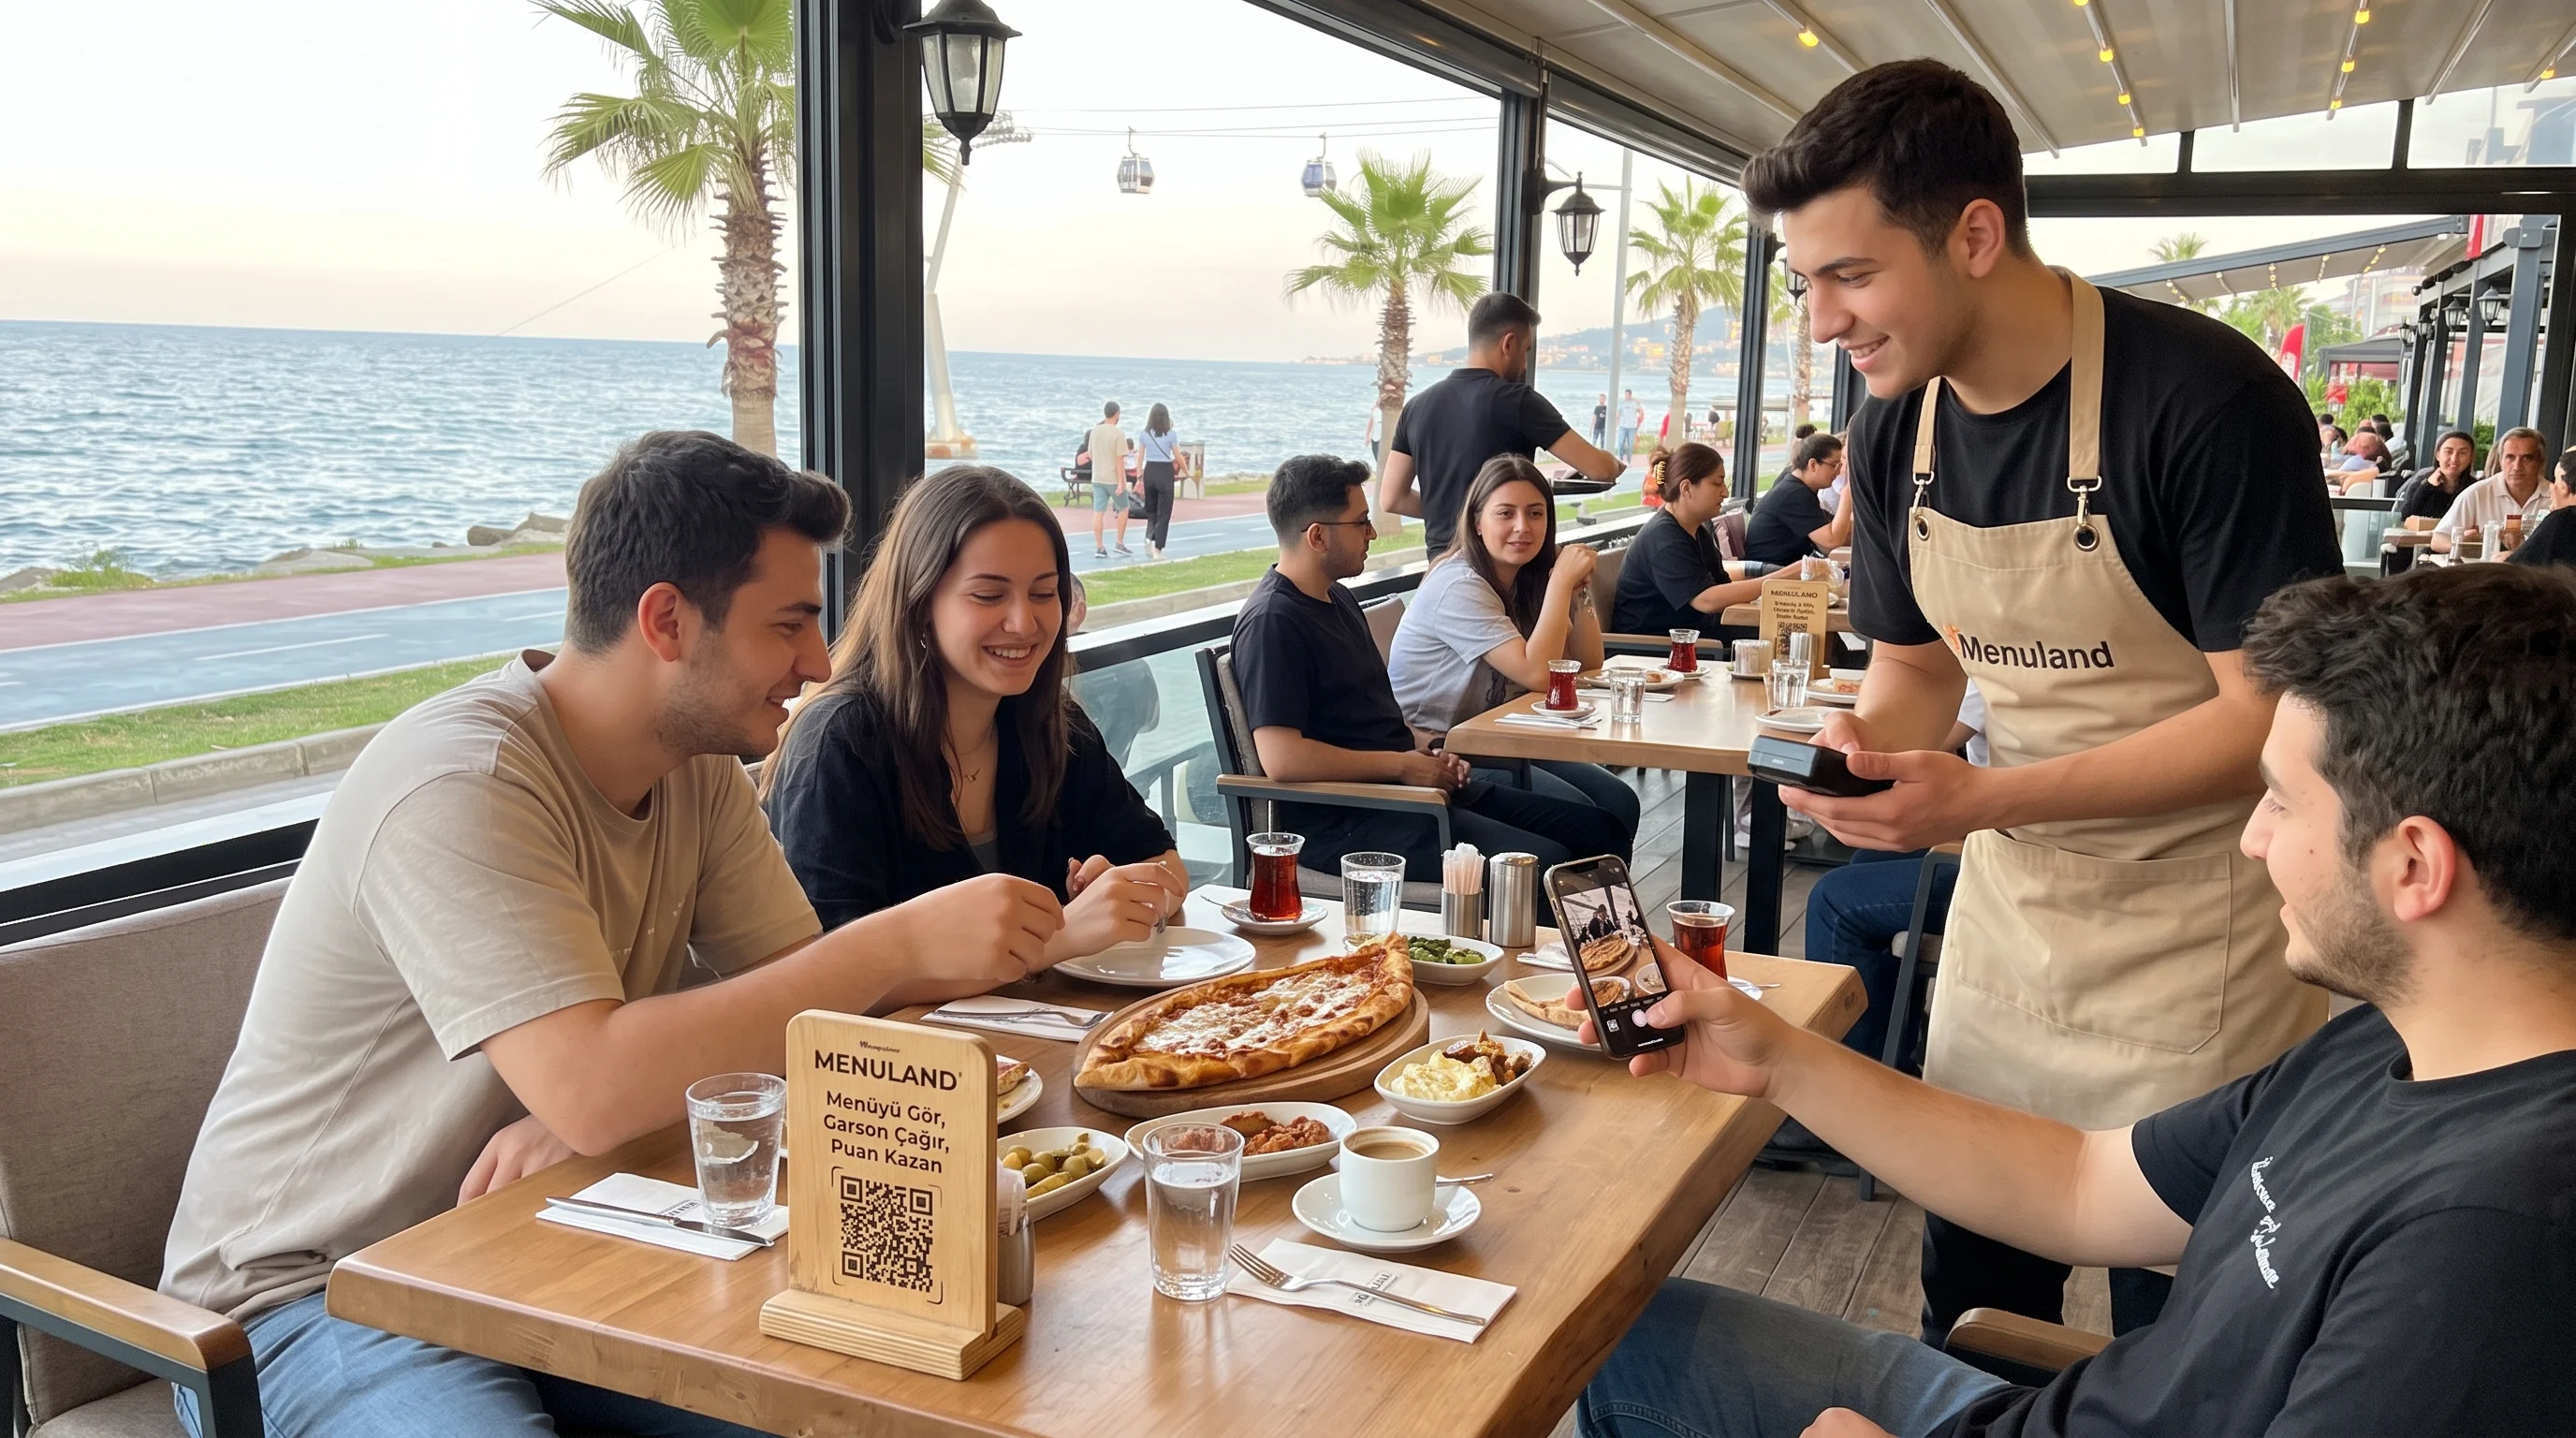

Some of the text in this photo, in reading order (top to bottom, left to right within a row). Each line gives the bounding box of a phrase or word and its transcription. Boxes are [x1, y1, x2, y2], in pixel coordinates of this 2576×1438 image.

[1958, 634, 2115, 669] Menuland
[827, 1090, 945, 1129] Menüyü Gör,
[824, 1114, 950, 1154] Garson Çağır,
[831, 1138, 943, 1174] Puan Kazan
